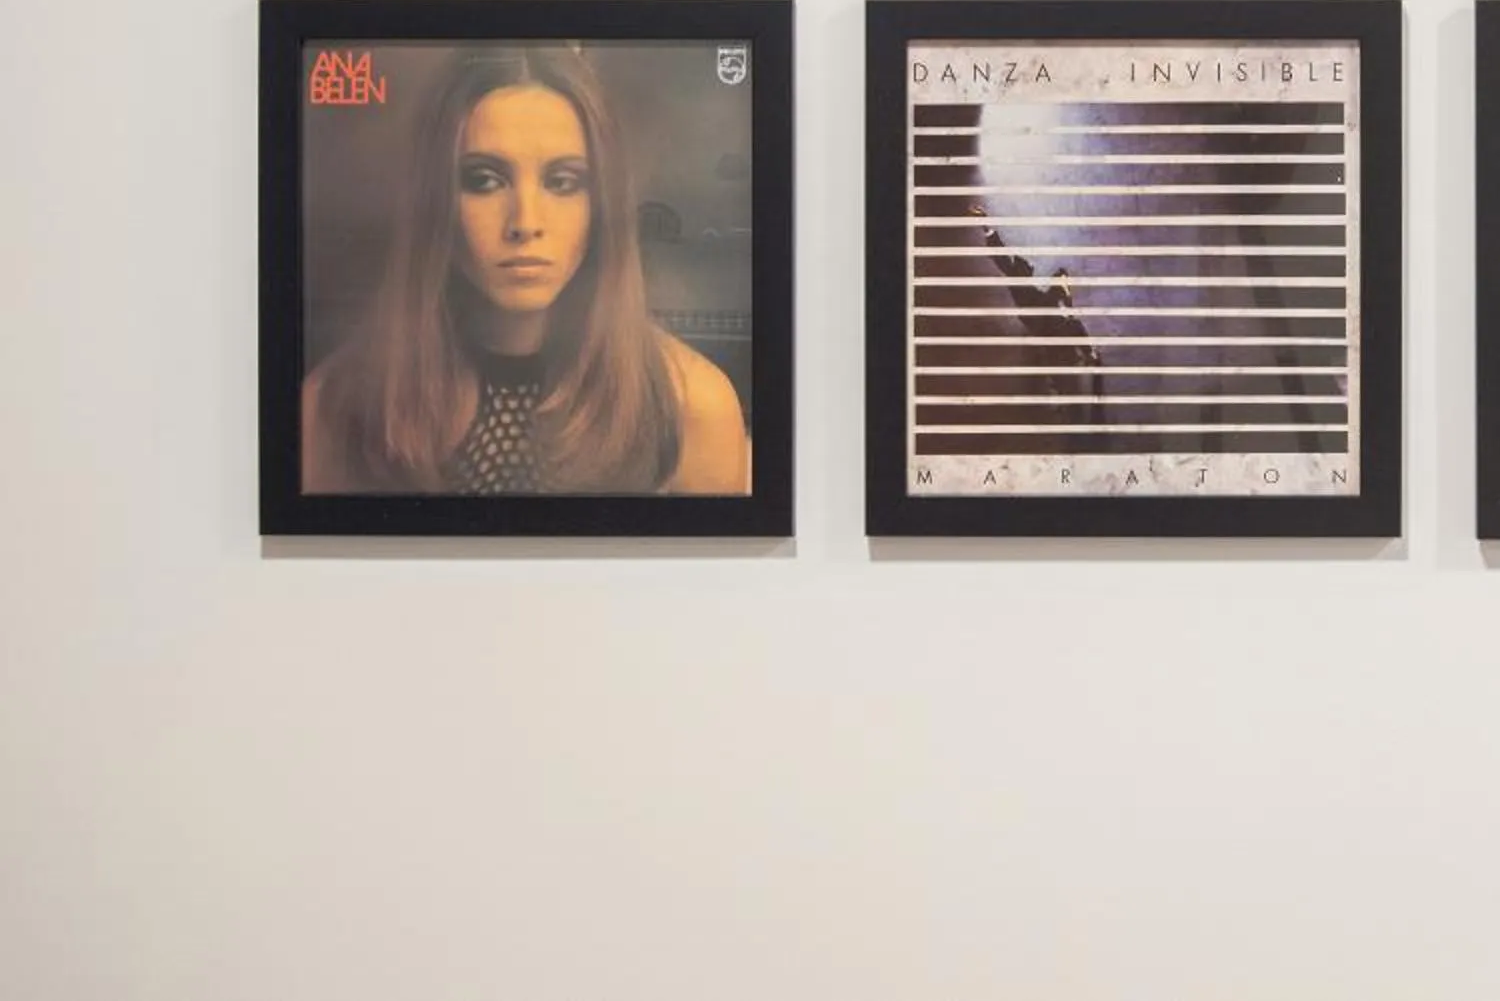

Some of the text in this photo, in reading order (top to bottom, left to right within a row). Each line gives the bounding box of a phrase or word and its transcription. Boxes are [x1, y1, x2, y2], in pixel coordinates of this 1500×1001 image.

[312, 51, 371, 78] ANA
[913, 61, 1345, 83] DANZA INVISIBLE
[310, 76, 386, 104] BELEN
[916, 469, 1347, 487] MARATON
